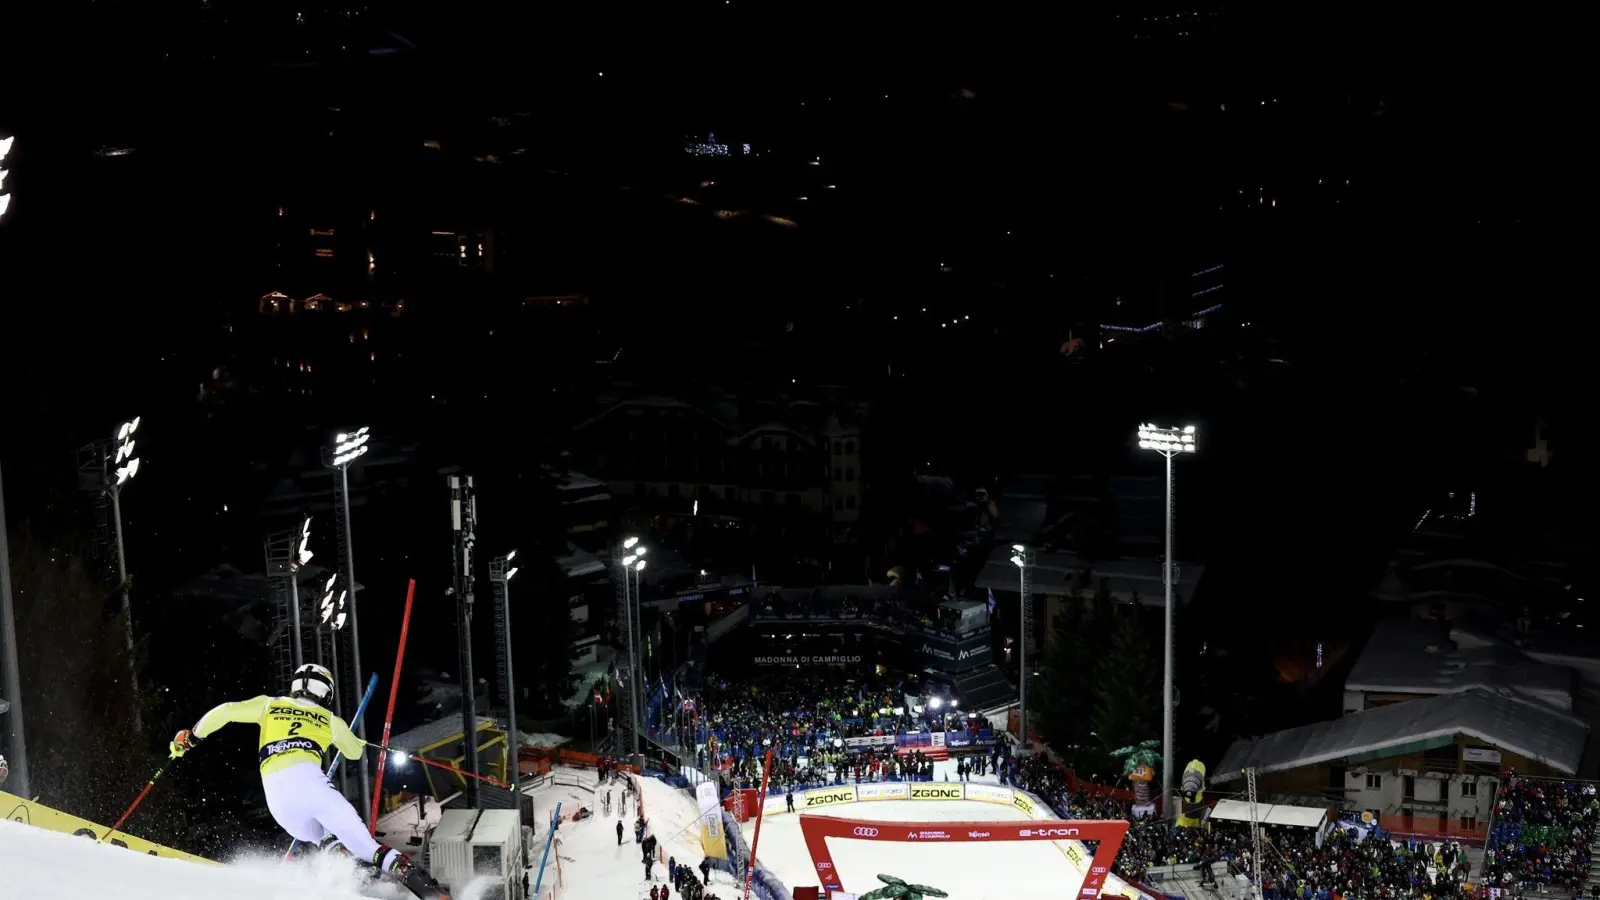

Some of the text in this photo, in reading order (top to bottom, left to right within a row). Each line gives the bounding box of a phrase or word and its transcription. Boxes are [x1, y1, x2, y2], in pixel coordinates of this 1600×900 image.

[269, 707, 329, 726] ZGONC
[287, 721, 303, 736] 2
[806, 792, 853, 806] ZGONC
[912, 789, 960, 798] ZGONC
[1019, 828, 1079, 836] e-tron
